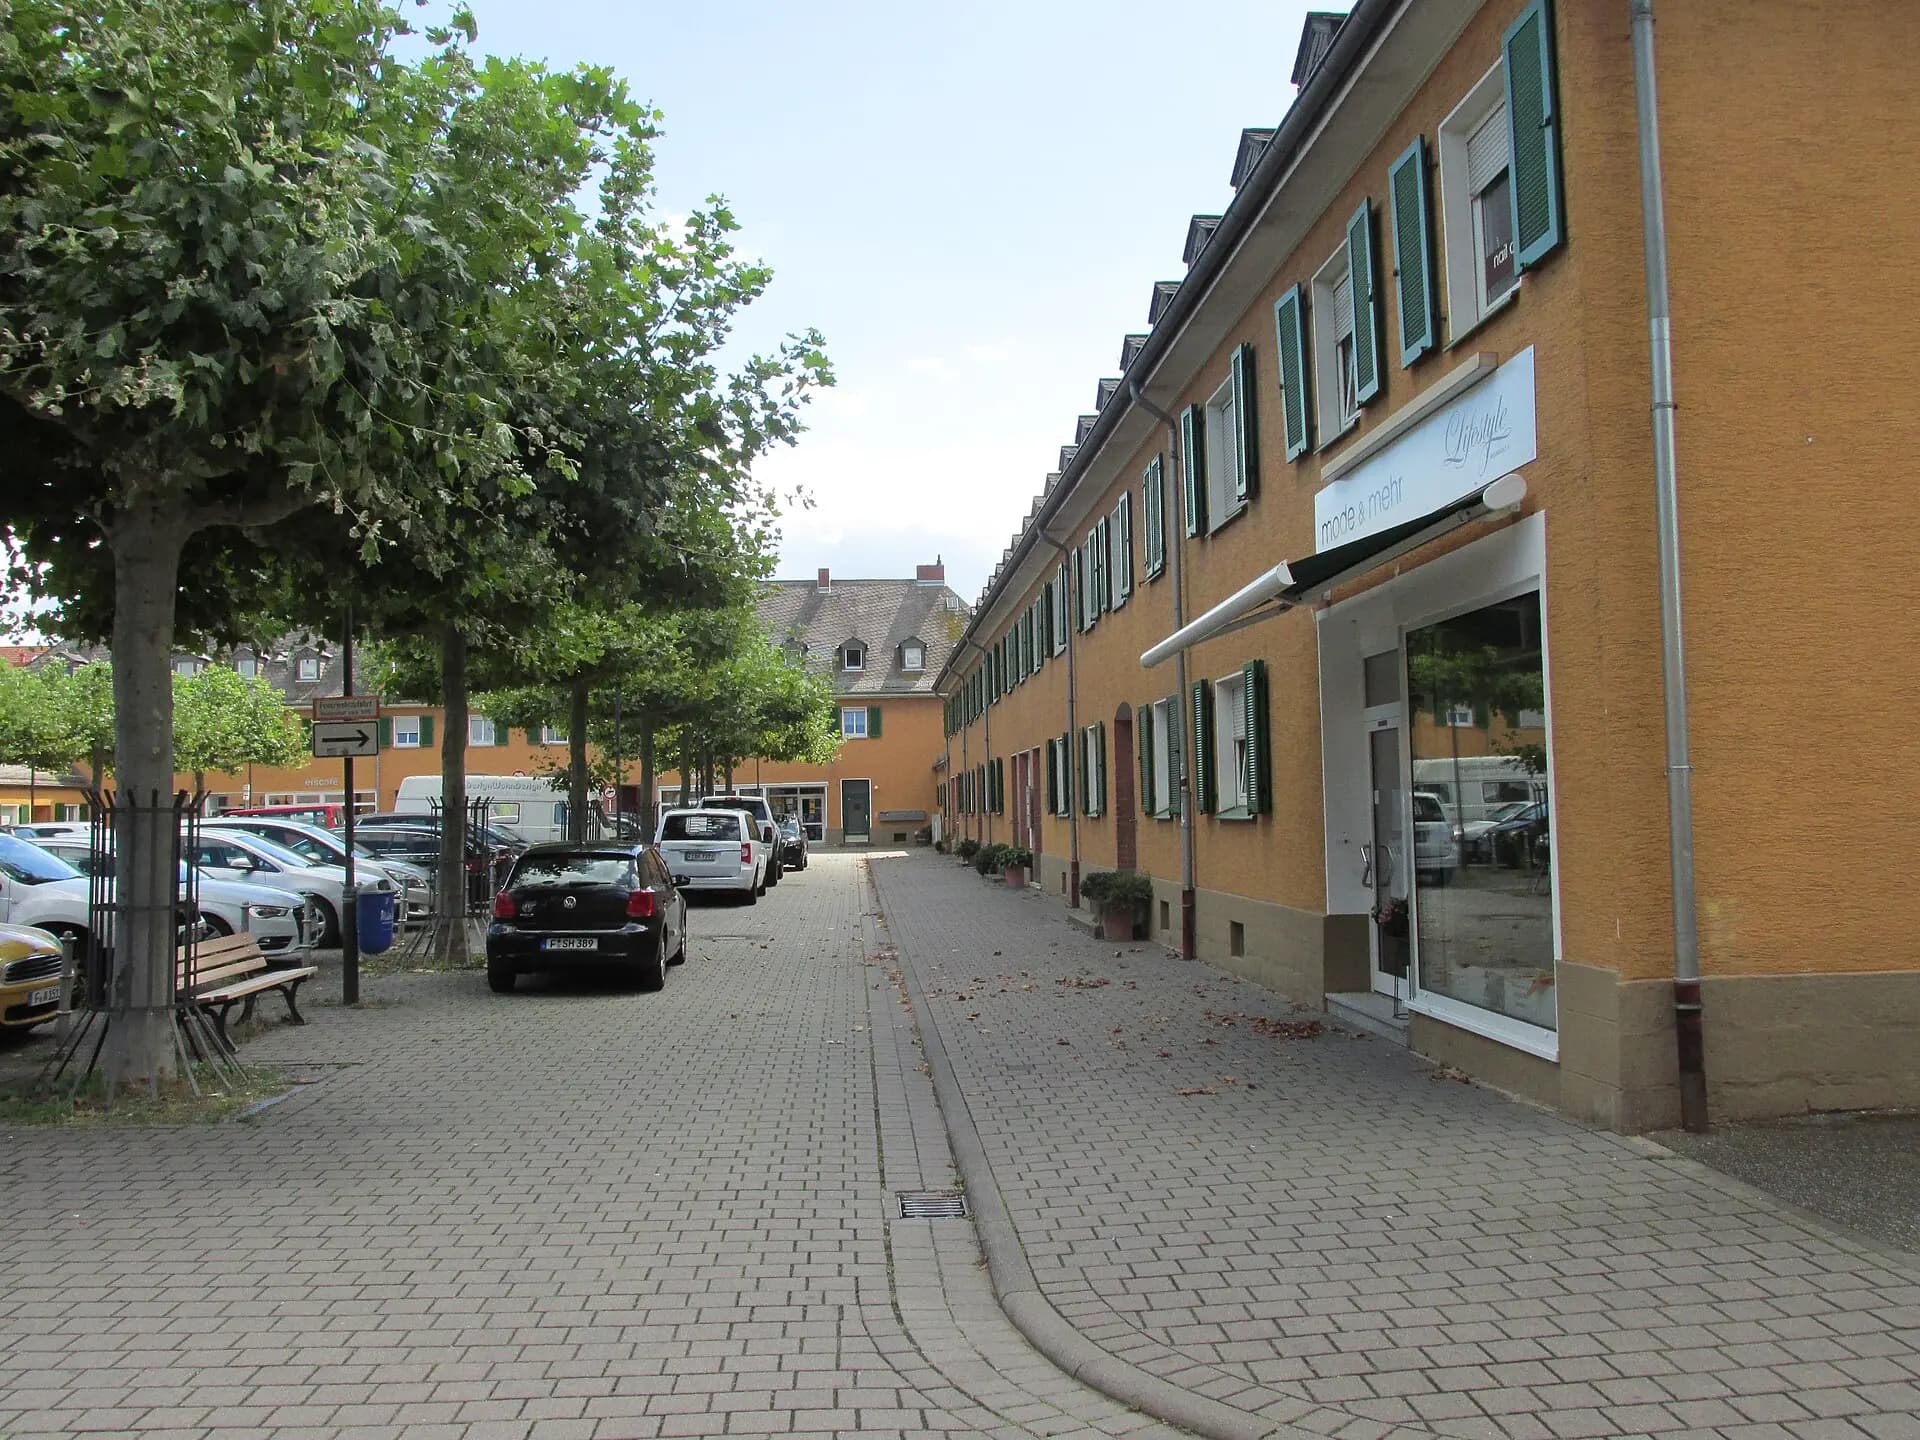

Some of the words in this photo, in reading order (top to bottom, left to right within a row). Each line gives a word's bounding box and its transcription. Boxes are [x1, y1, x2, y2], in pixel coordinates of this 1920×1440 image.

[1321, 503, 1355, 546] mode
[1358, 500, 1366, 526] &
[1368, 472, 1403, 520] mehr
